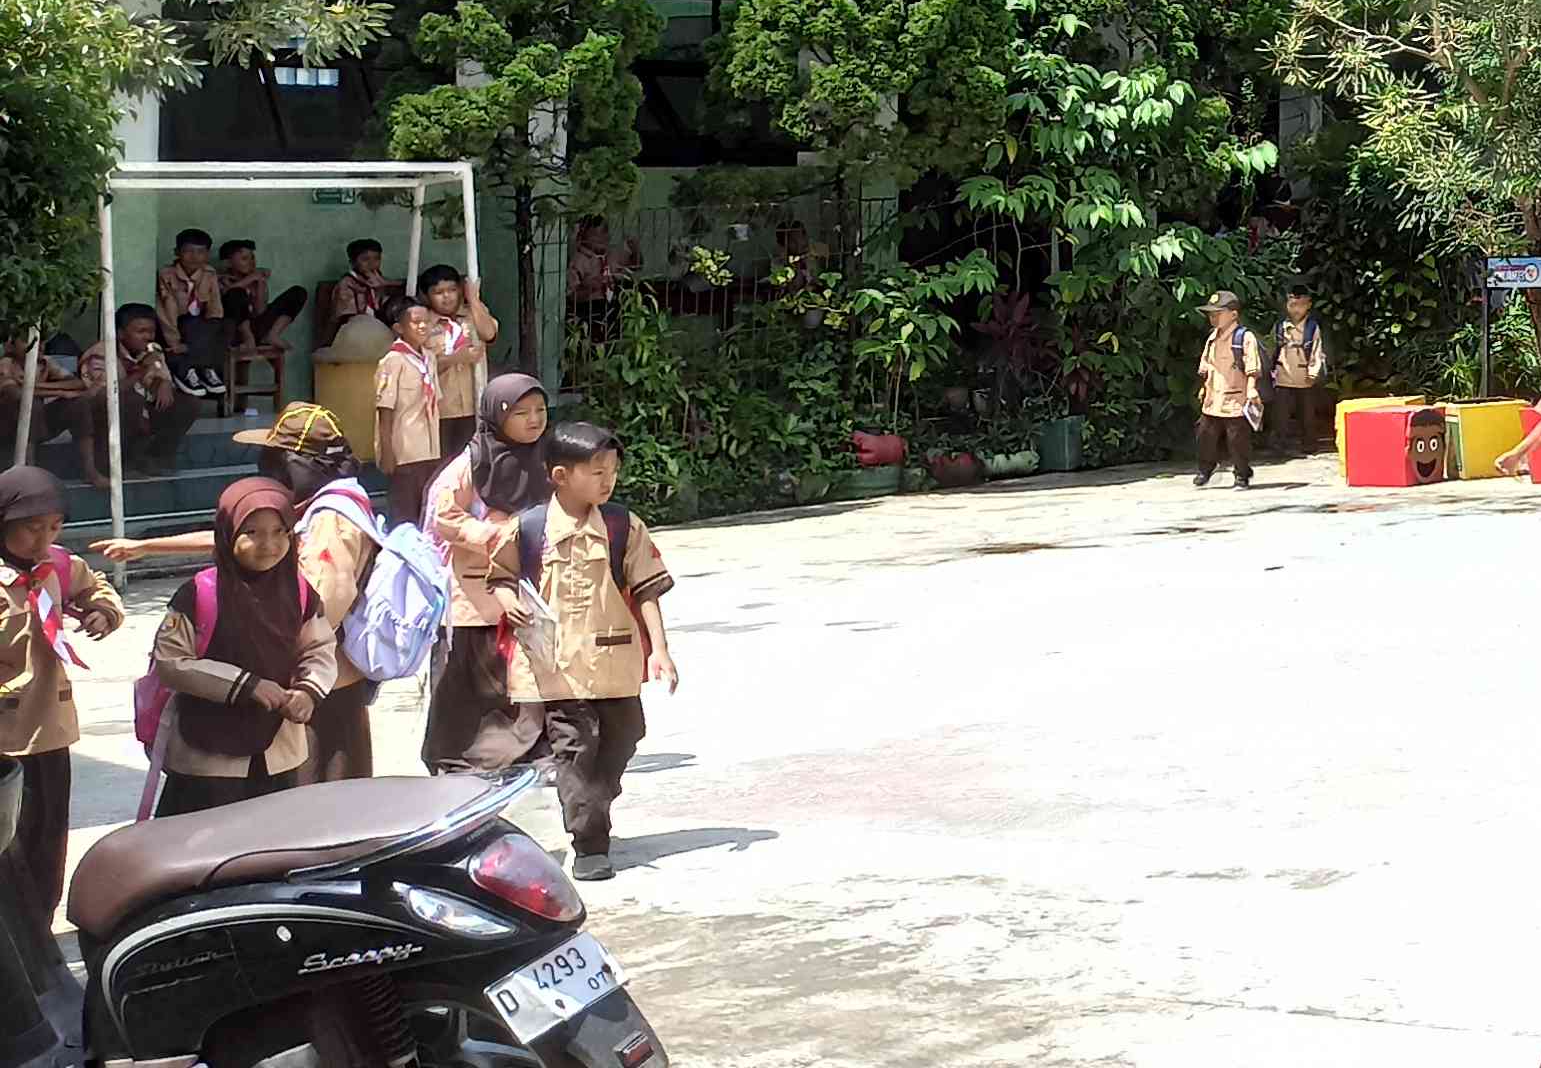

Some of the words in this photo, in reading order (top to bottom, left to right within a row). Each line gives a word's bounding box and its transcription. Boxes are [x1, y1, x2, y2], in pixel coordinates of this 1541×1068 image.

[298, 943, 423, 974] Scoopy
[496, 987, 521, 1016] D
[532, 946, 587, 991] 4293
[587, 971, 609, 992] 07
